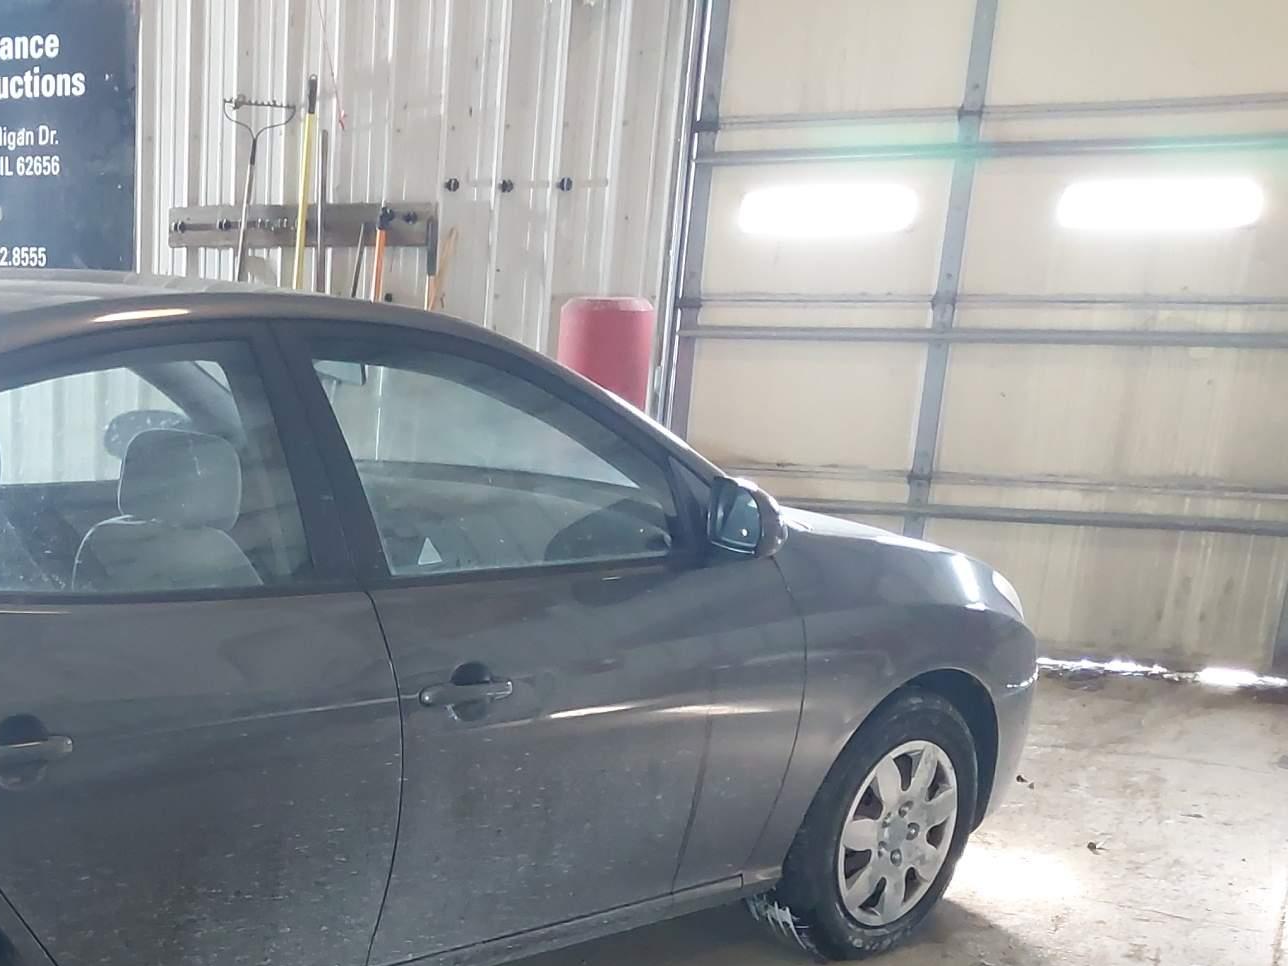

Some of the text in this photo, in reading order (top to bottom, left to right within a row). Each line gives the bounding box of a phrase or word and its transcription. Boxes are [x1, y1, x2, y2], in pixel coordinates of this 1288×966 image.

[38, 125, 59, 146] Dr.
[0, 157, 14, 176] IL
[16, 155, 60, 176] 62656
